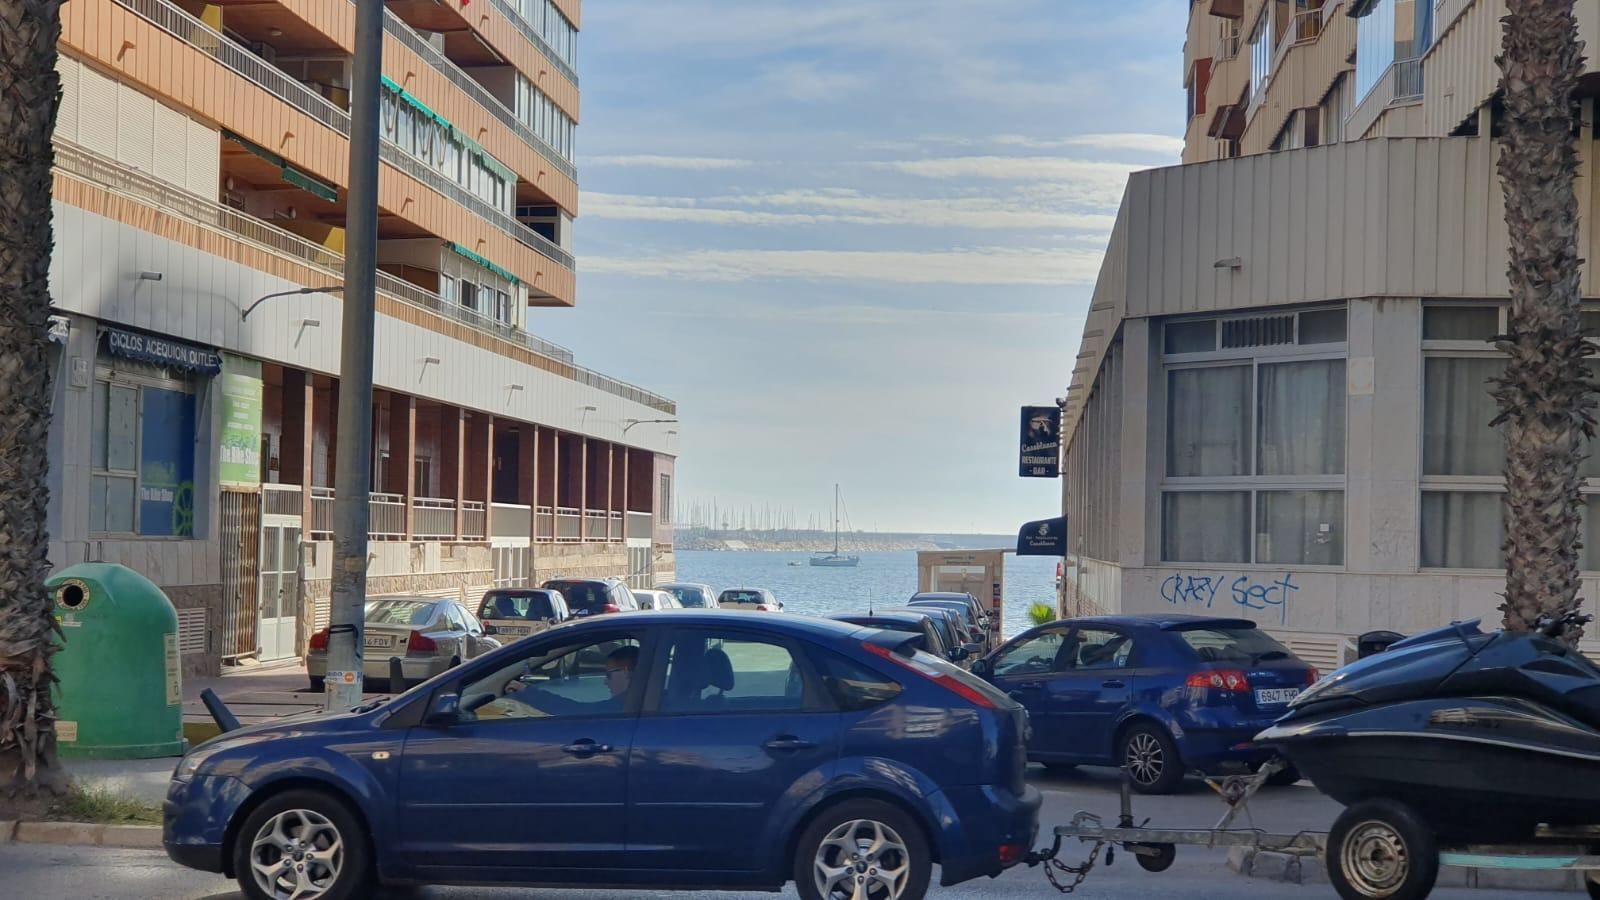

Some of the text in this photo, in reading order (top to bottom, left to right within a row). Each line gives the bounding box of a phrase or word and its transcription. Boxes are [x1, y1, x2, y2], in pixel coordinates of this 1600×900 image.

[110, 331, 143, 352] CICLOS
[145, 339, 187, 362] ACEQUION
[1021, 456, 1057, 464] RESTAURANTE
[1032, 466, 1046, 475] BAR
[1160, 573, 1225, 608] CRAZY
[1261, 690, 1280, 702] 6947
